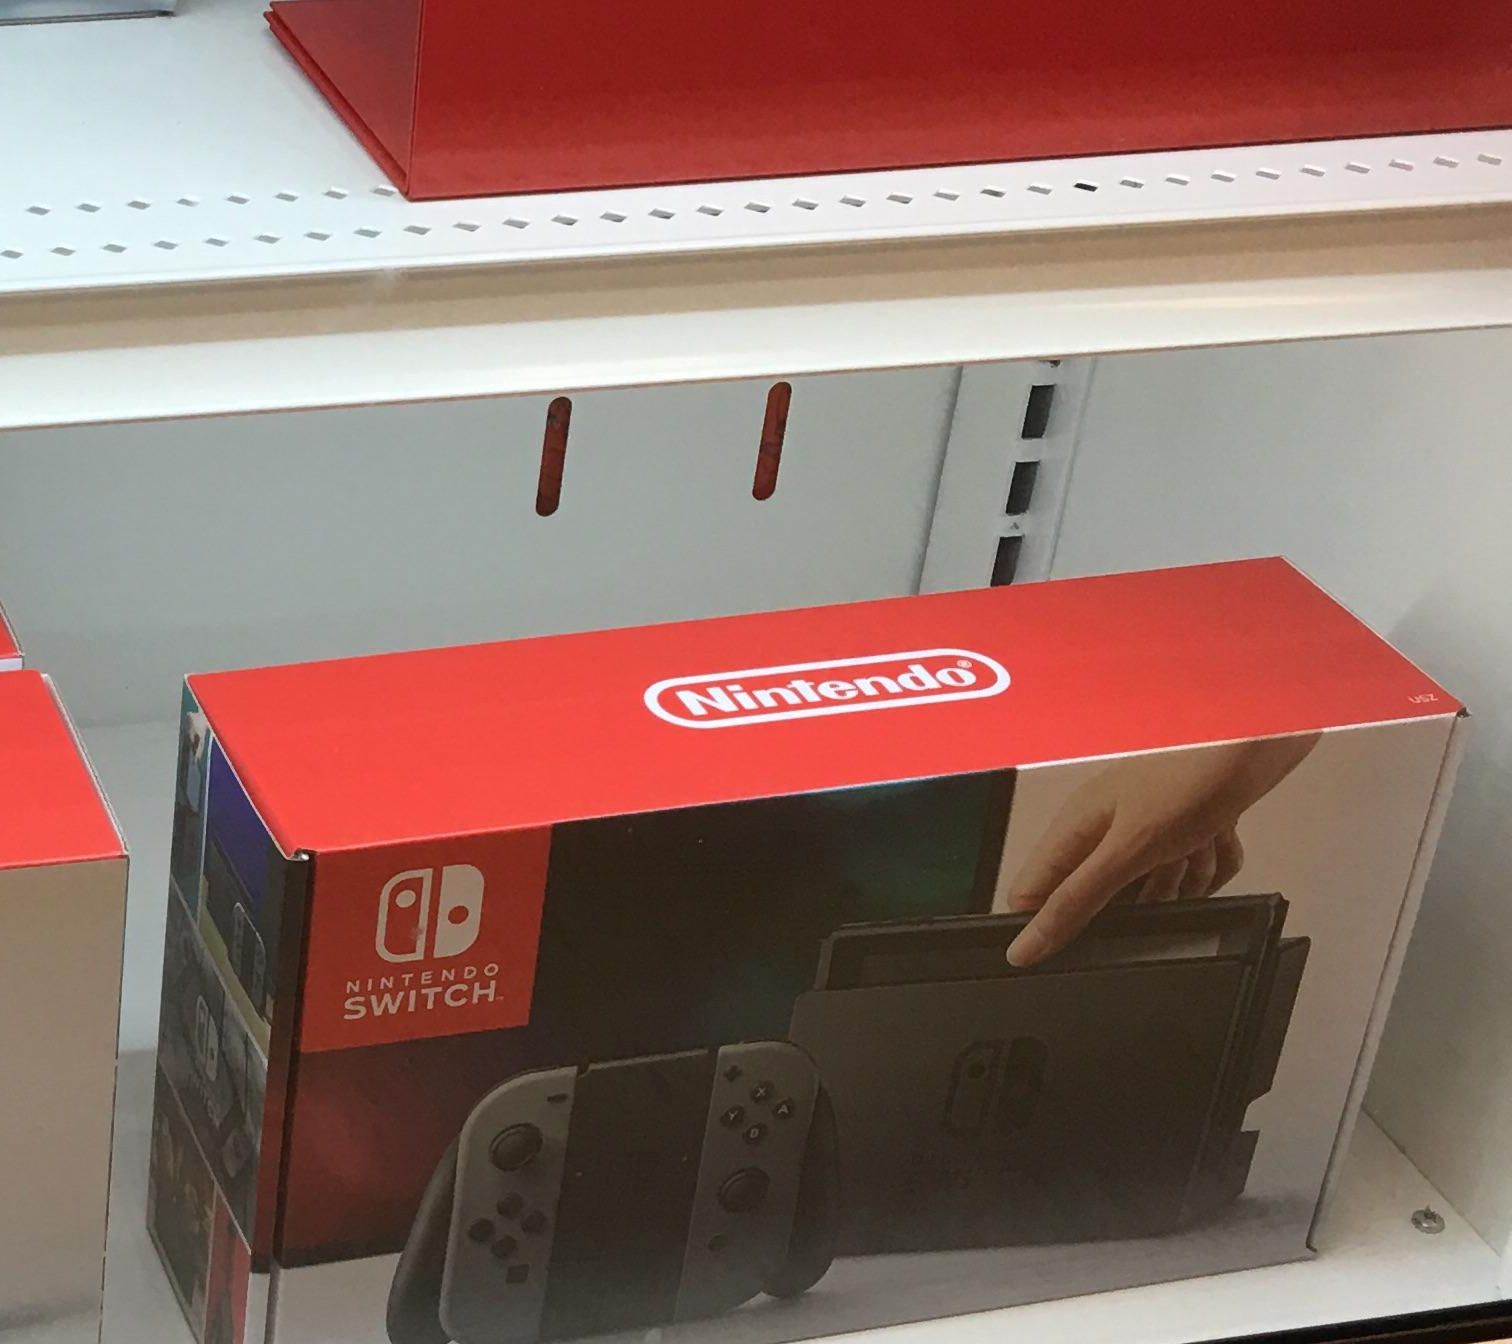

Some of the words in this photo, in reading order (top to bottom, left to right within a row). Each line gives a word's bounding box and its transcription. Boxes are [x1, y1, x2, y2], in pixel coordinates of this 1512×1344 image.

[675, 663, 977, 716] Nintendo
[346, 963, 499, 994] NINTENDO
[343, 980, 497, 1020] SWITCH
